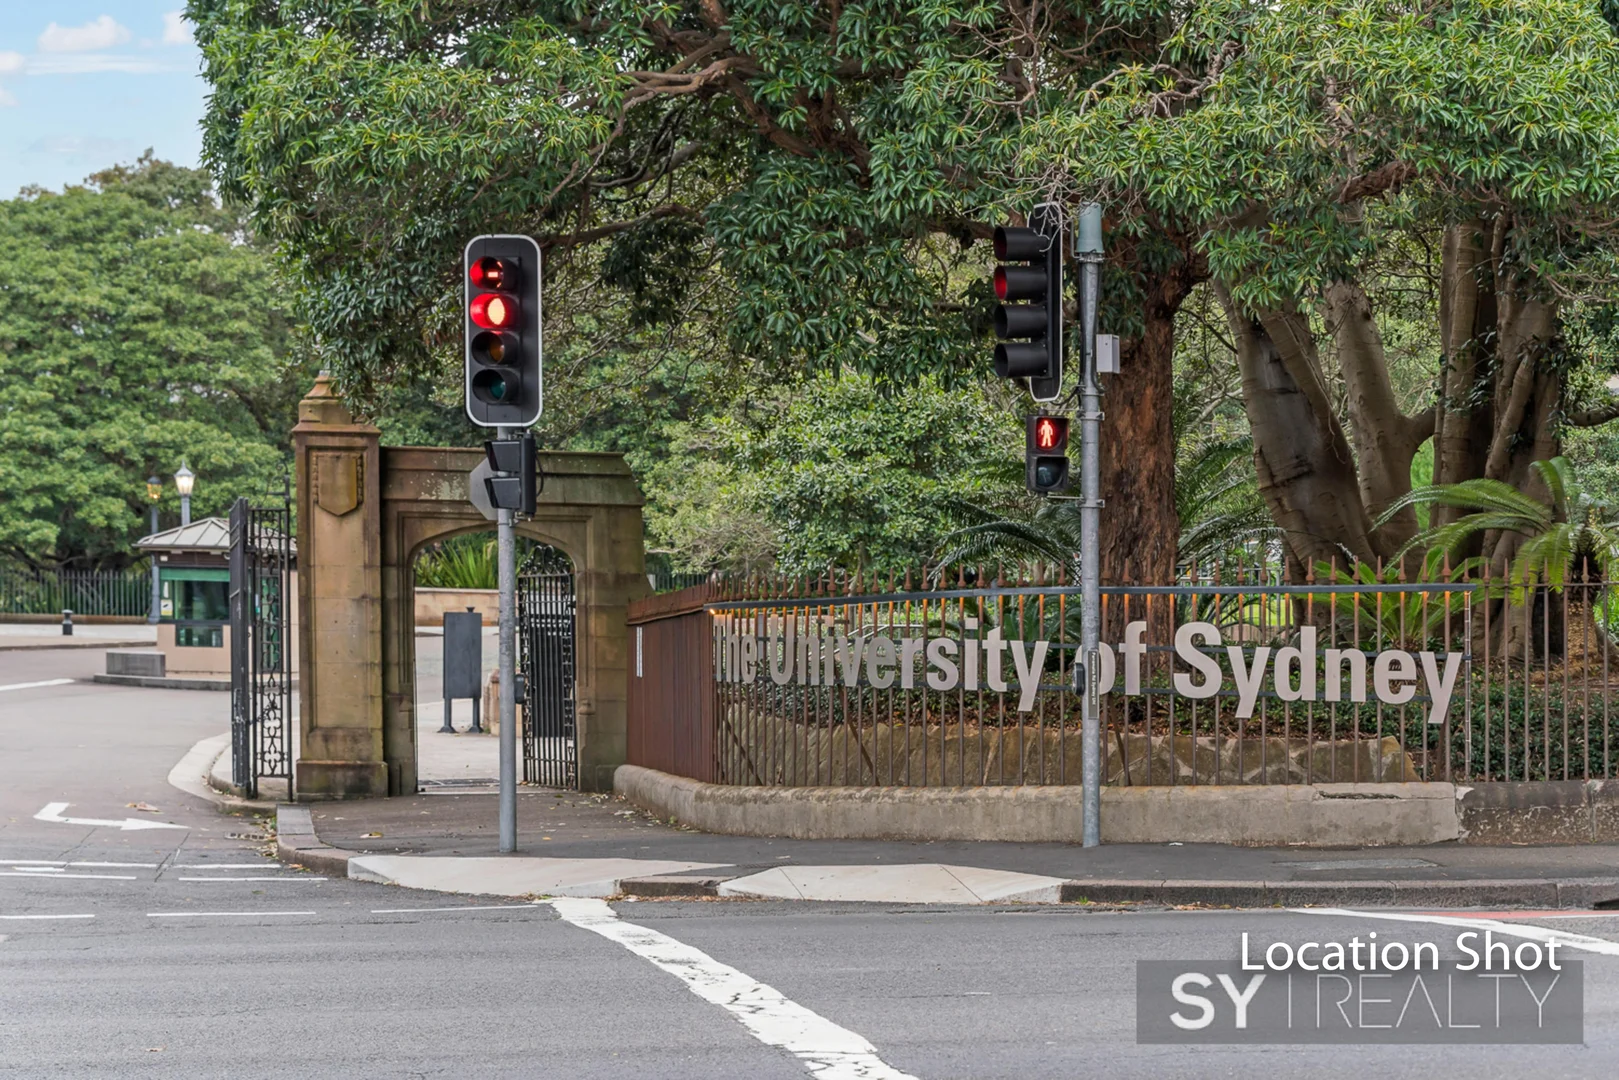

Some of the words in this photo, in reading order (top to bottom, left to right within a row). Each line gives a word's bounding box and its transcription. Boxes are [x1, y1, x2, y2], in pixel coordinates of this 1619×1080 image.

[713, 613, 758, 684] The
[769, 613, 1049, 712] University
[1073, 620, 1147, 696] of
[1173, 621, 1463, 724] Sydney
